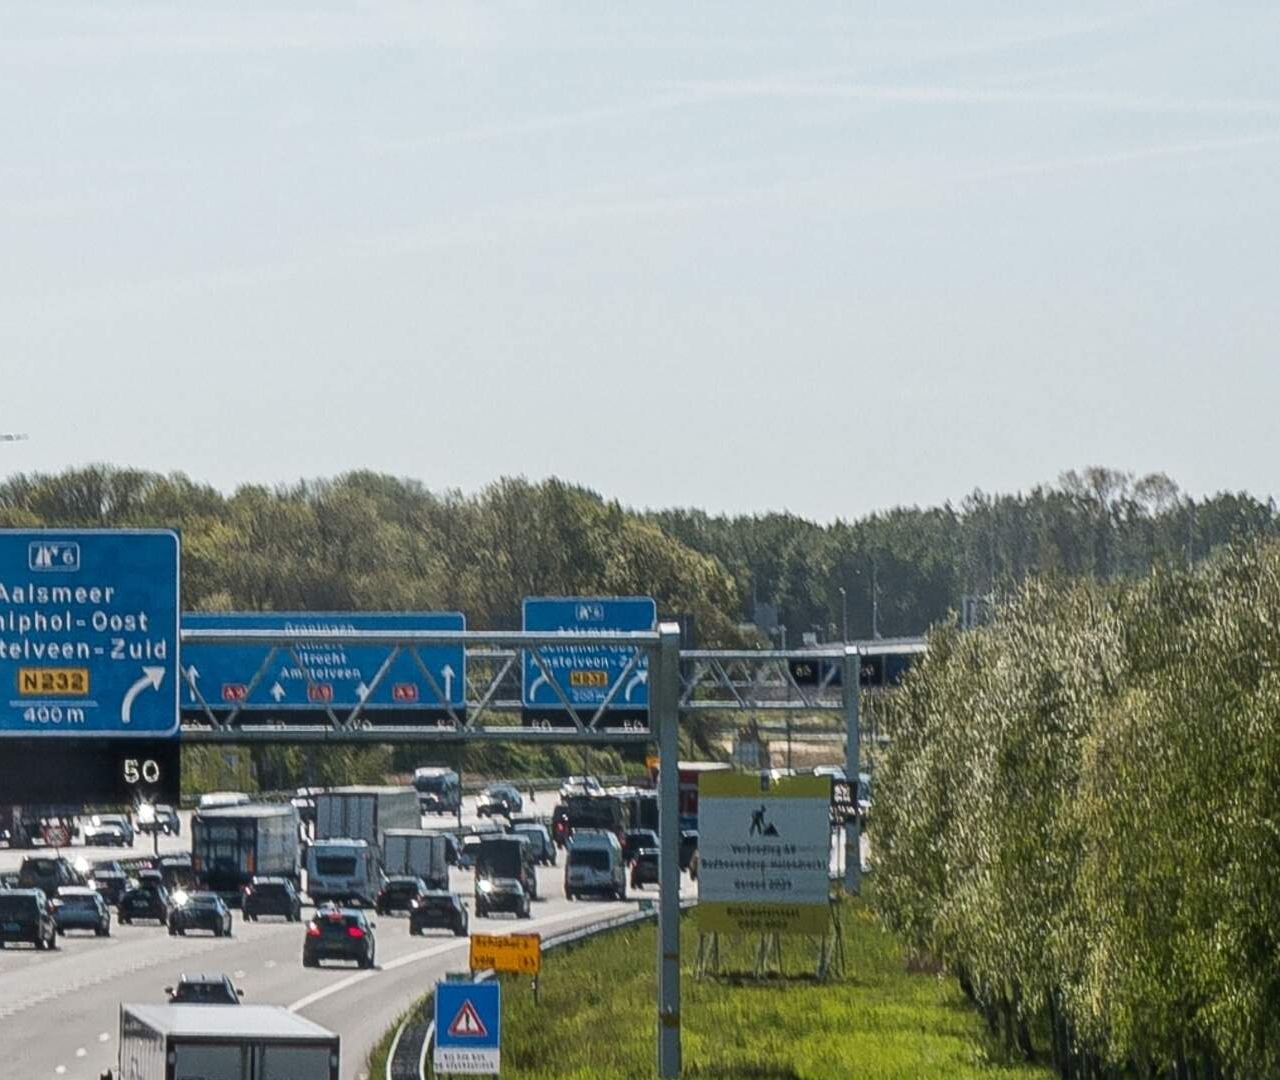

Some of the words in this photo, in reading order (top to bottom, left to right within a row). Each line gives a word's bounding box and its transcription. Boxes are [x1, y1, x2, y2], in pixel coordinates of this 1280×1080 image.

[62, 549, 74, 565] 6
[23, 673, 84, 691] N232
[23, 706, 63, 723] 400
[67, 708, 85, 723] m
[123, 758, 160, 784] 50
